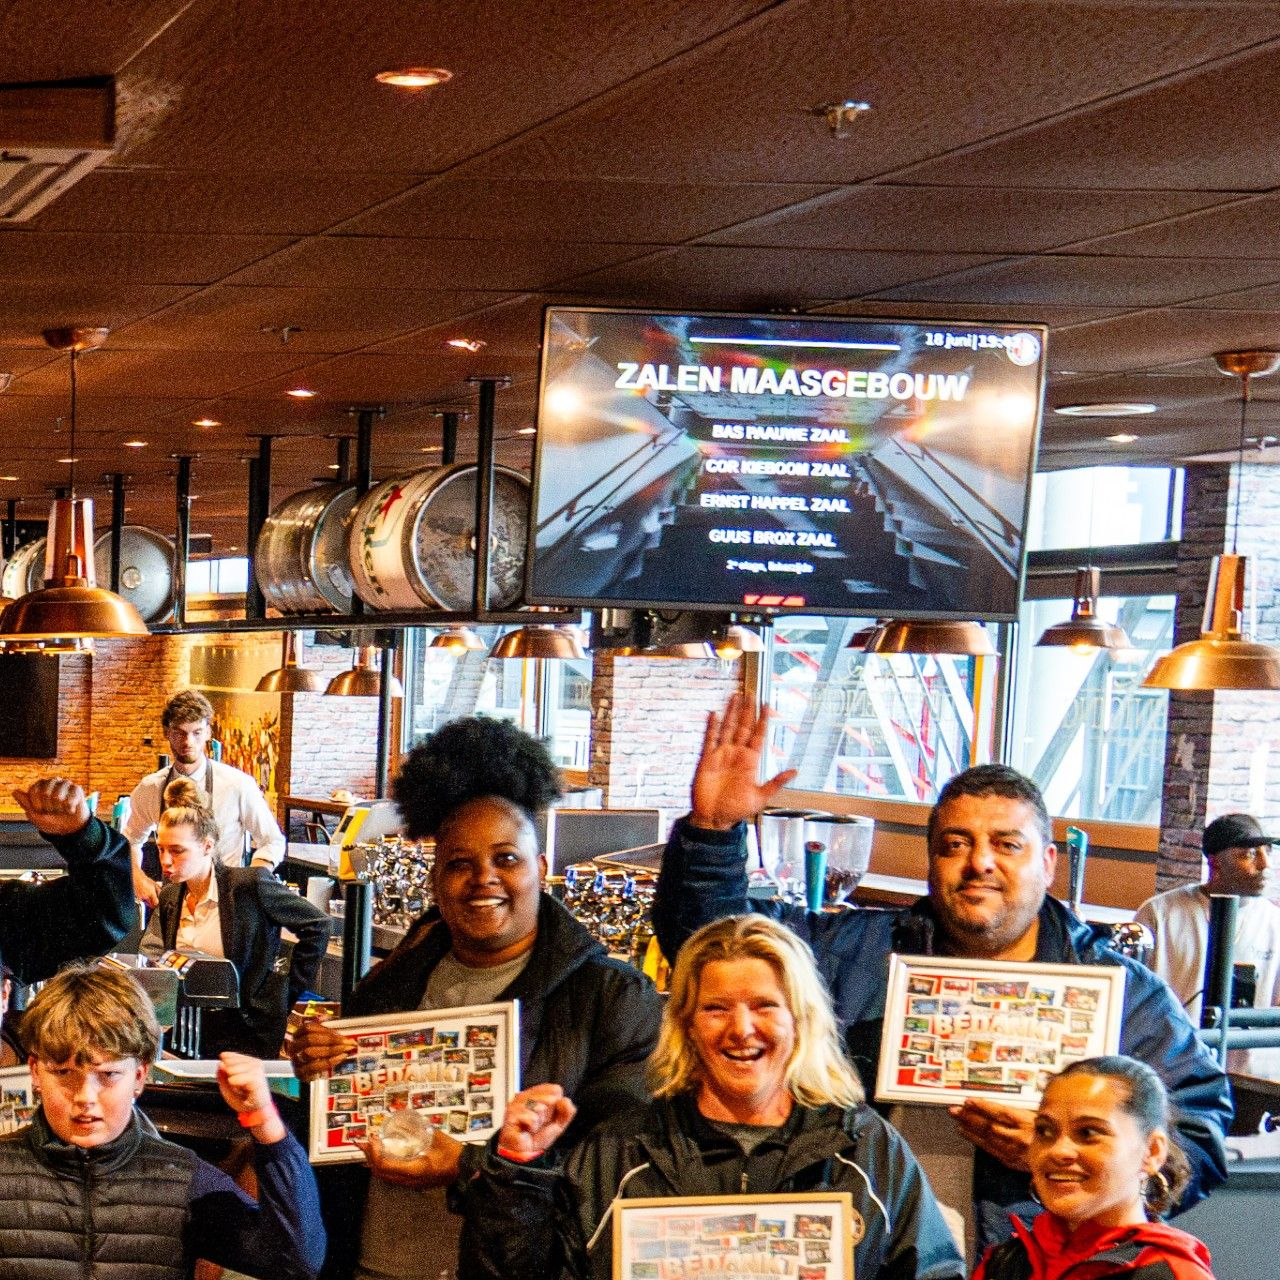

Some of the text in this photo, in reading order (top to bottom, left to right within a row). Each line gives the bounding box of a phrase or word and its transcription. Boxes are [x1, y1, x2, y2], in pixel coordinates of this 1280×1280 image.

[615, 362, 970, 401] ZALEN MAASGEBOUW
[712, 424, 745, 439] BAS
[810, 428, 851, 443] ZAAL
[705, 459, 851, 478] COR KIEBOOM ZAAL
[700, 493, 851, 513] ERNST HAPPEL ZAAL
[708, 528, 837, 548] GUUS BROX ZAAL
[354, 1062, 468, 1092] BEDANKT
